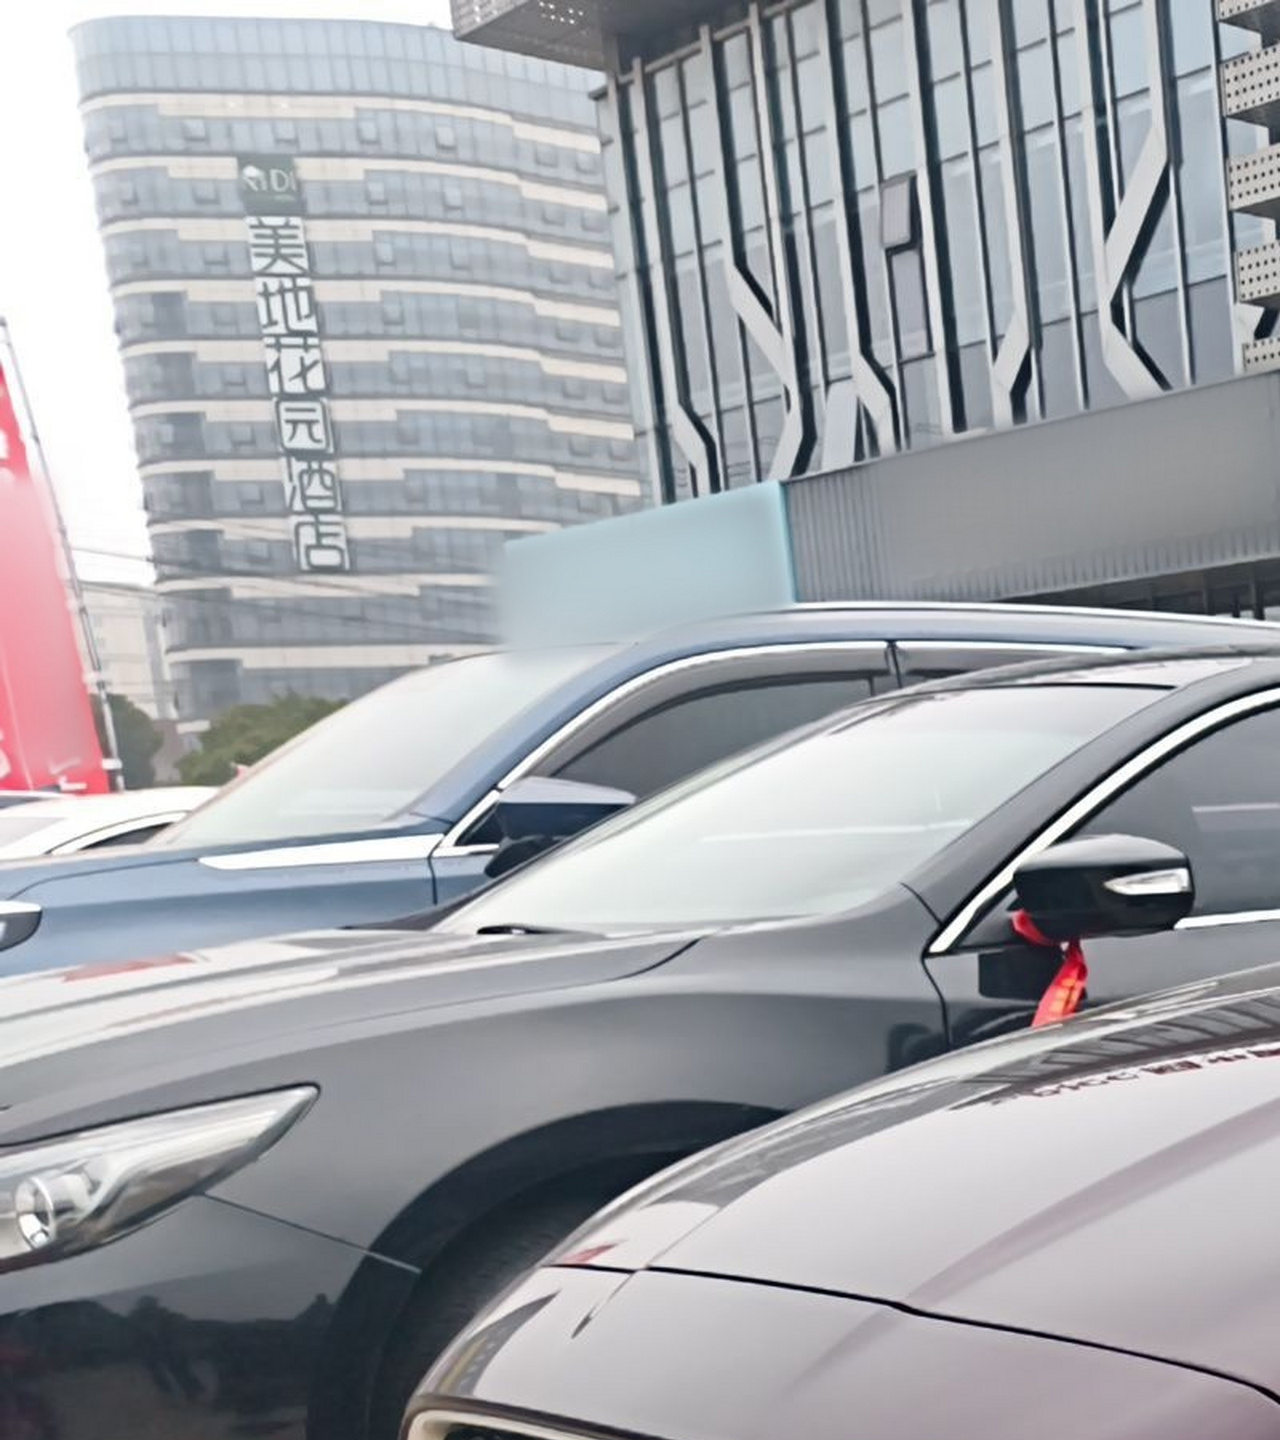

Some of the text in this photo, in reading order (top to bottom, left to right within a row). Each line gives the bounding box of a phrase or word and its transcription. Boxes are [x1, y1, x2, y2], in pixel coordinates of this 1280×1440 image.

[247, 217, 350, 572] 美地花园酒店
